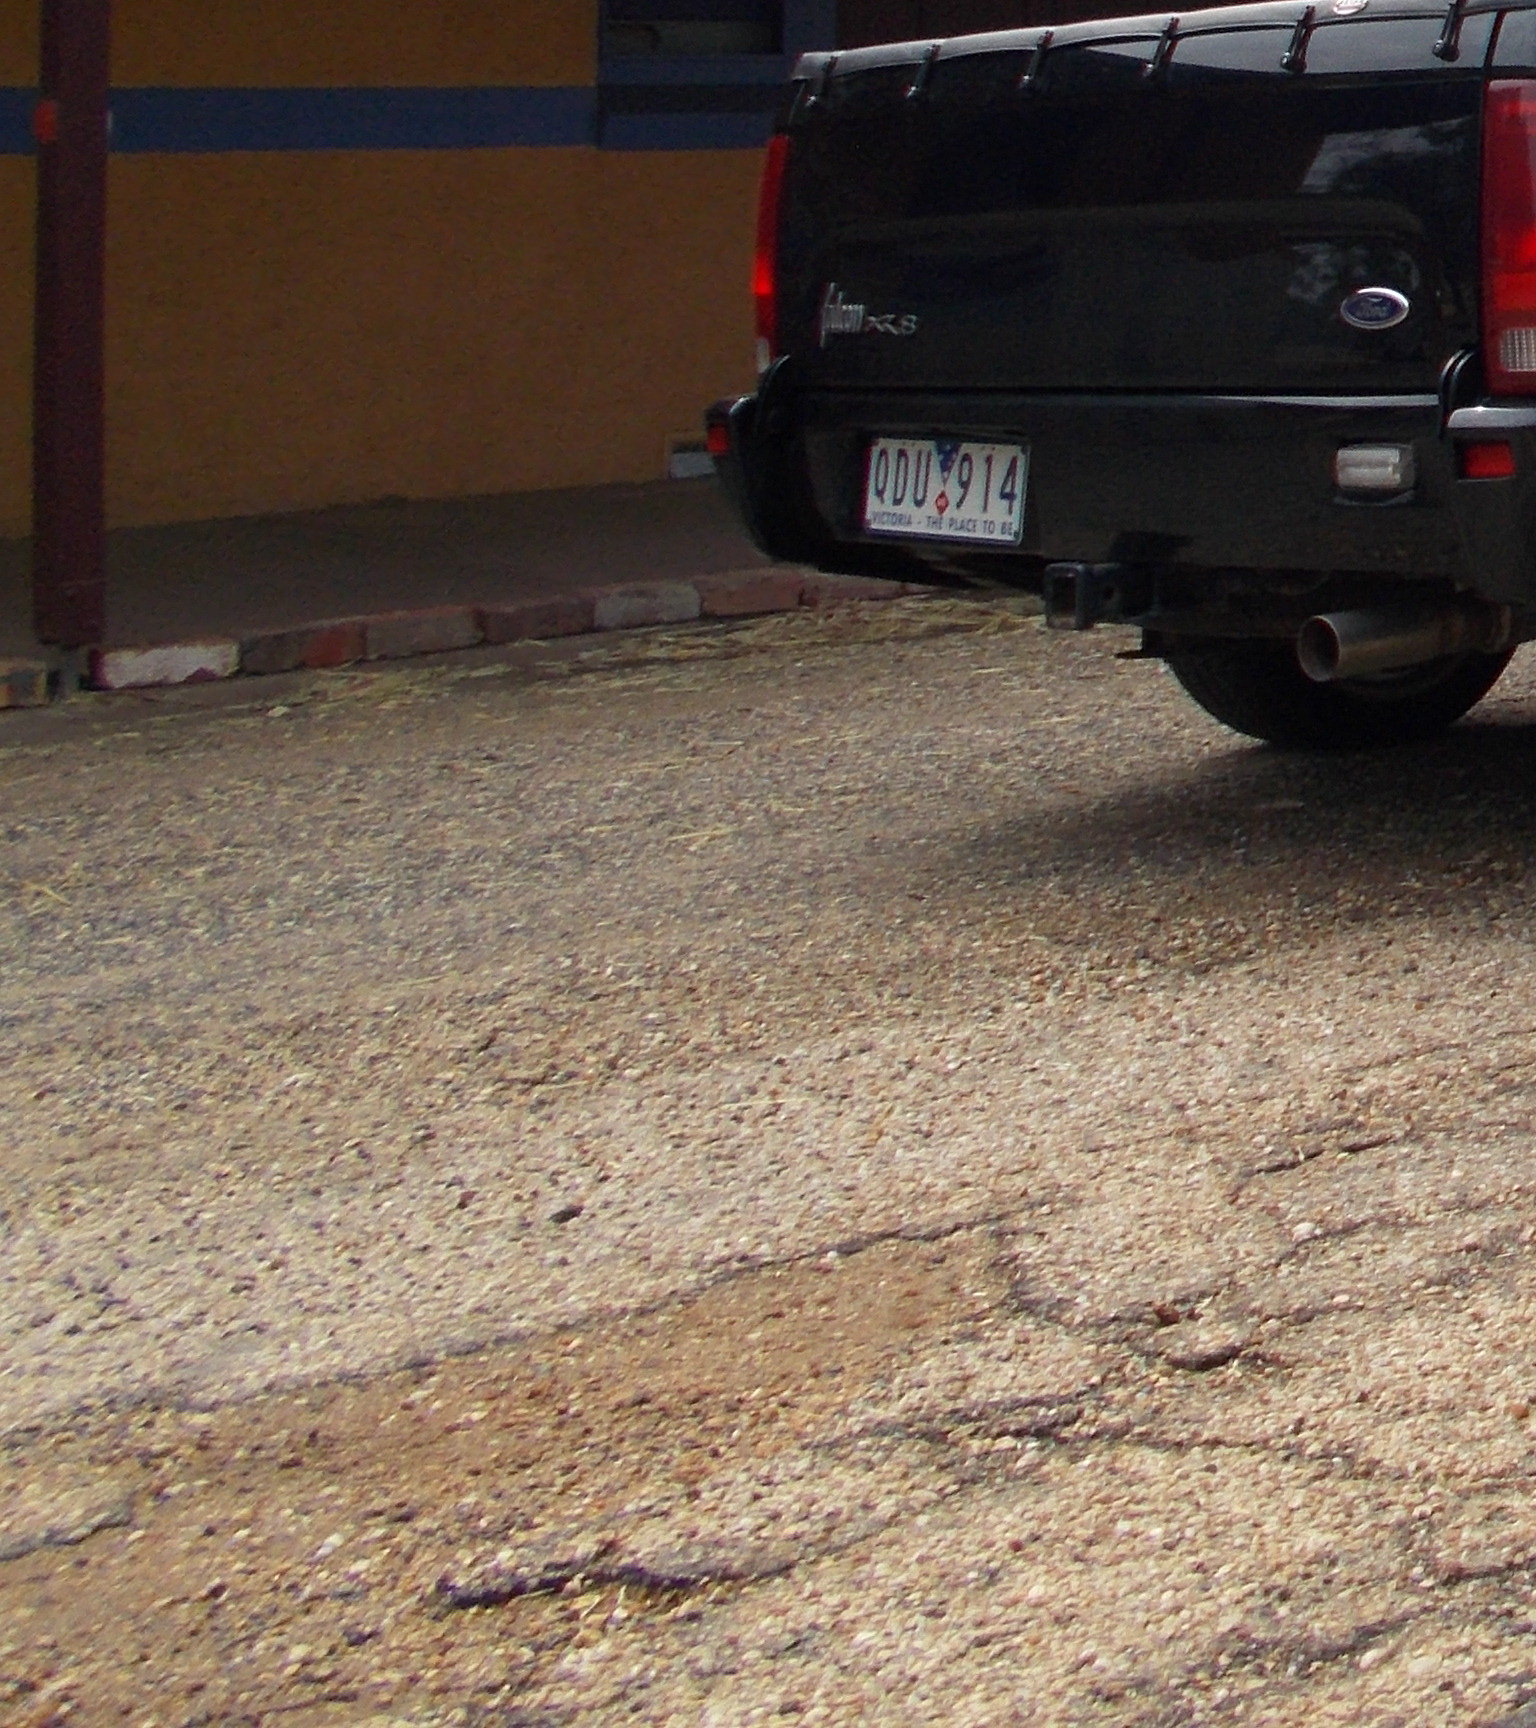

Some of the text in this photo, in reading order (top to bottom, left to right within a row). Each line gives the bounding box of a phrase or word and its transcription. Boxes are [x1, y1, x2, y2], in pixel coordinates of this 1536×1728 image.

[874, 447, 1018, 516] QDU 914
[871, 510, 912, 527] VICTORIA
[925, 515, 943, 531] THE
[948, 517, 978, 534] PLACE
[982, 519, 996, 535] TO
[1000, 521, 1014, 536] BE
